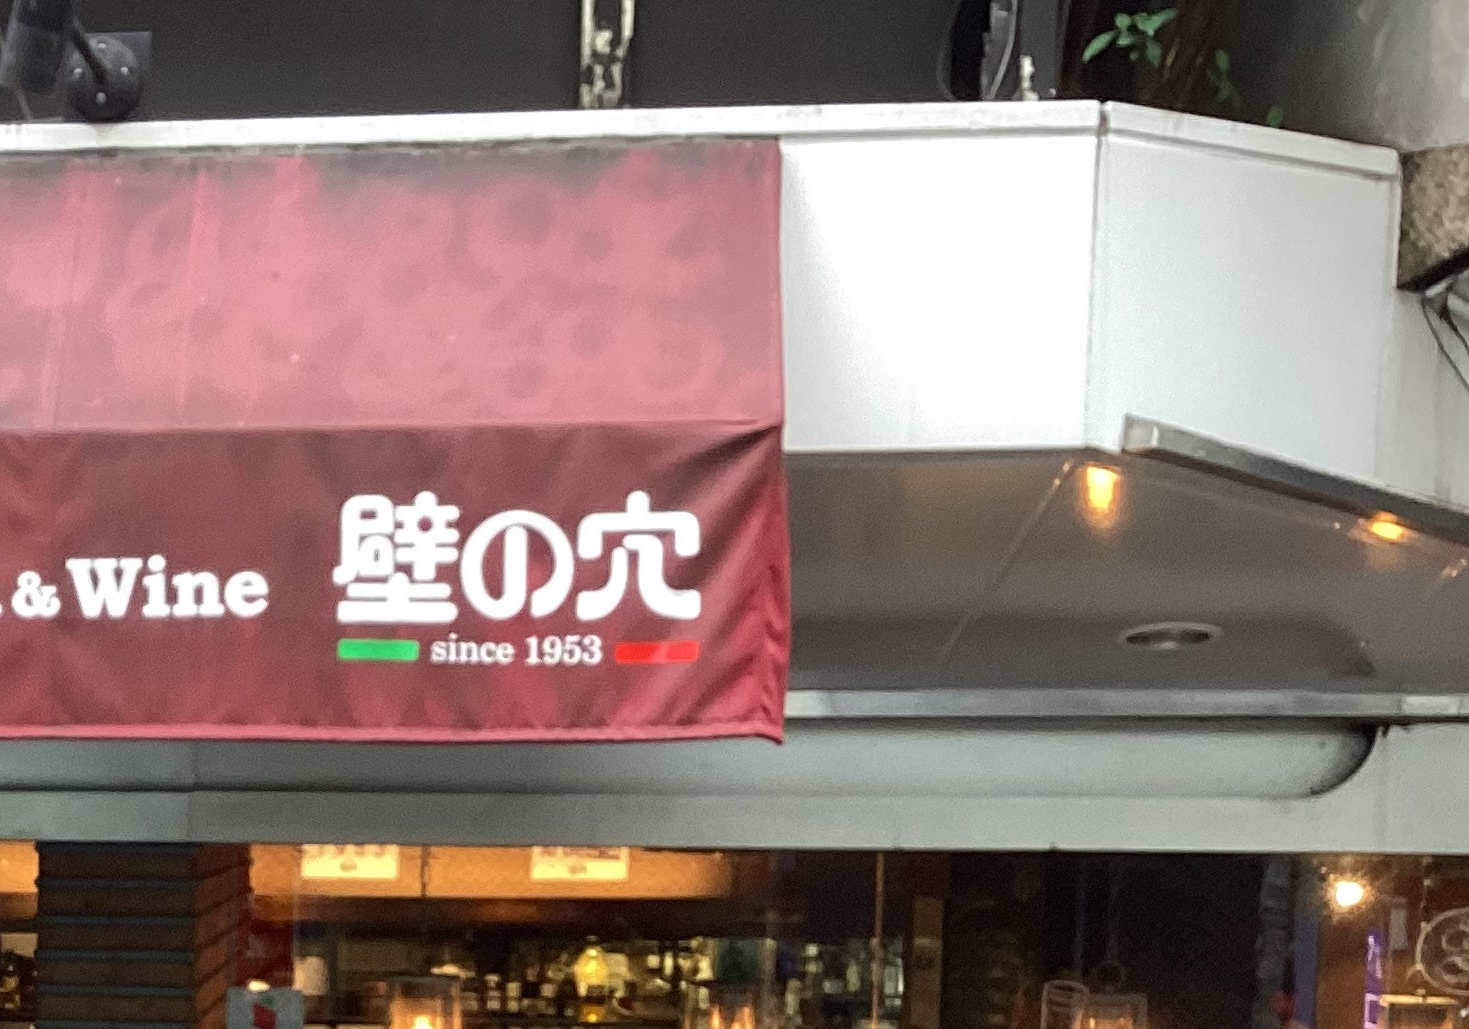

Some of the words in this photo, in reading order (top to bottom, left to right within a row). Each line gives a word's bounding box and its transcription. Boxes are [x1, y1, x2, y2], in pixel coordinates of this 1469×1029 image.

[10, 570, 62, 619] &
[65, 555, 270, 619] Wine
[332, 489, 702, 624] 壁の穴
[430, 633, 515, 665] since
[524, 635, 604, 666] 1953
